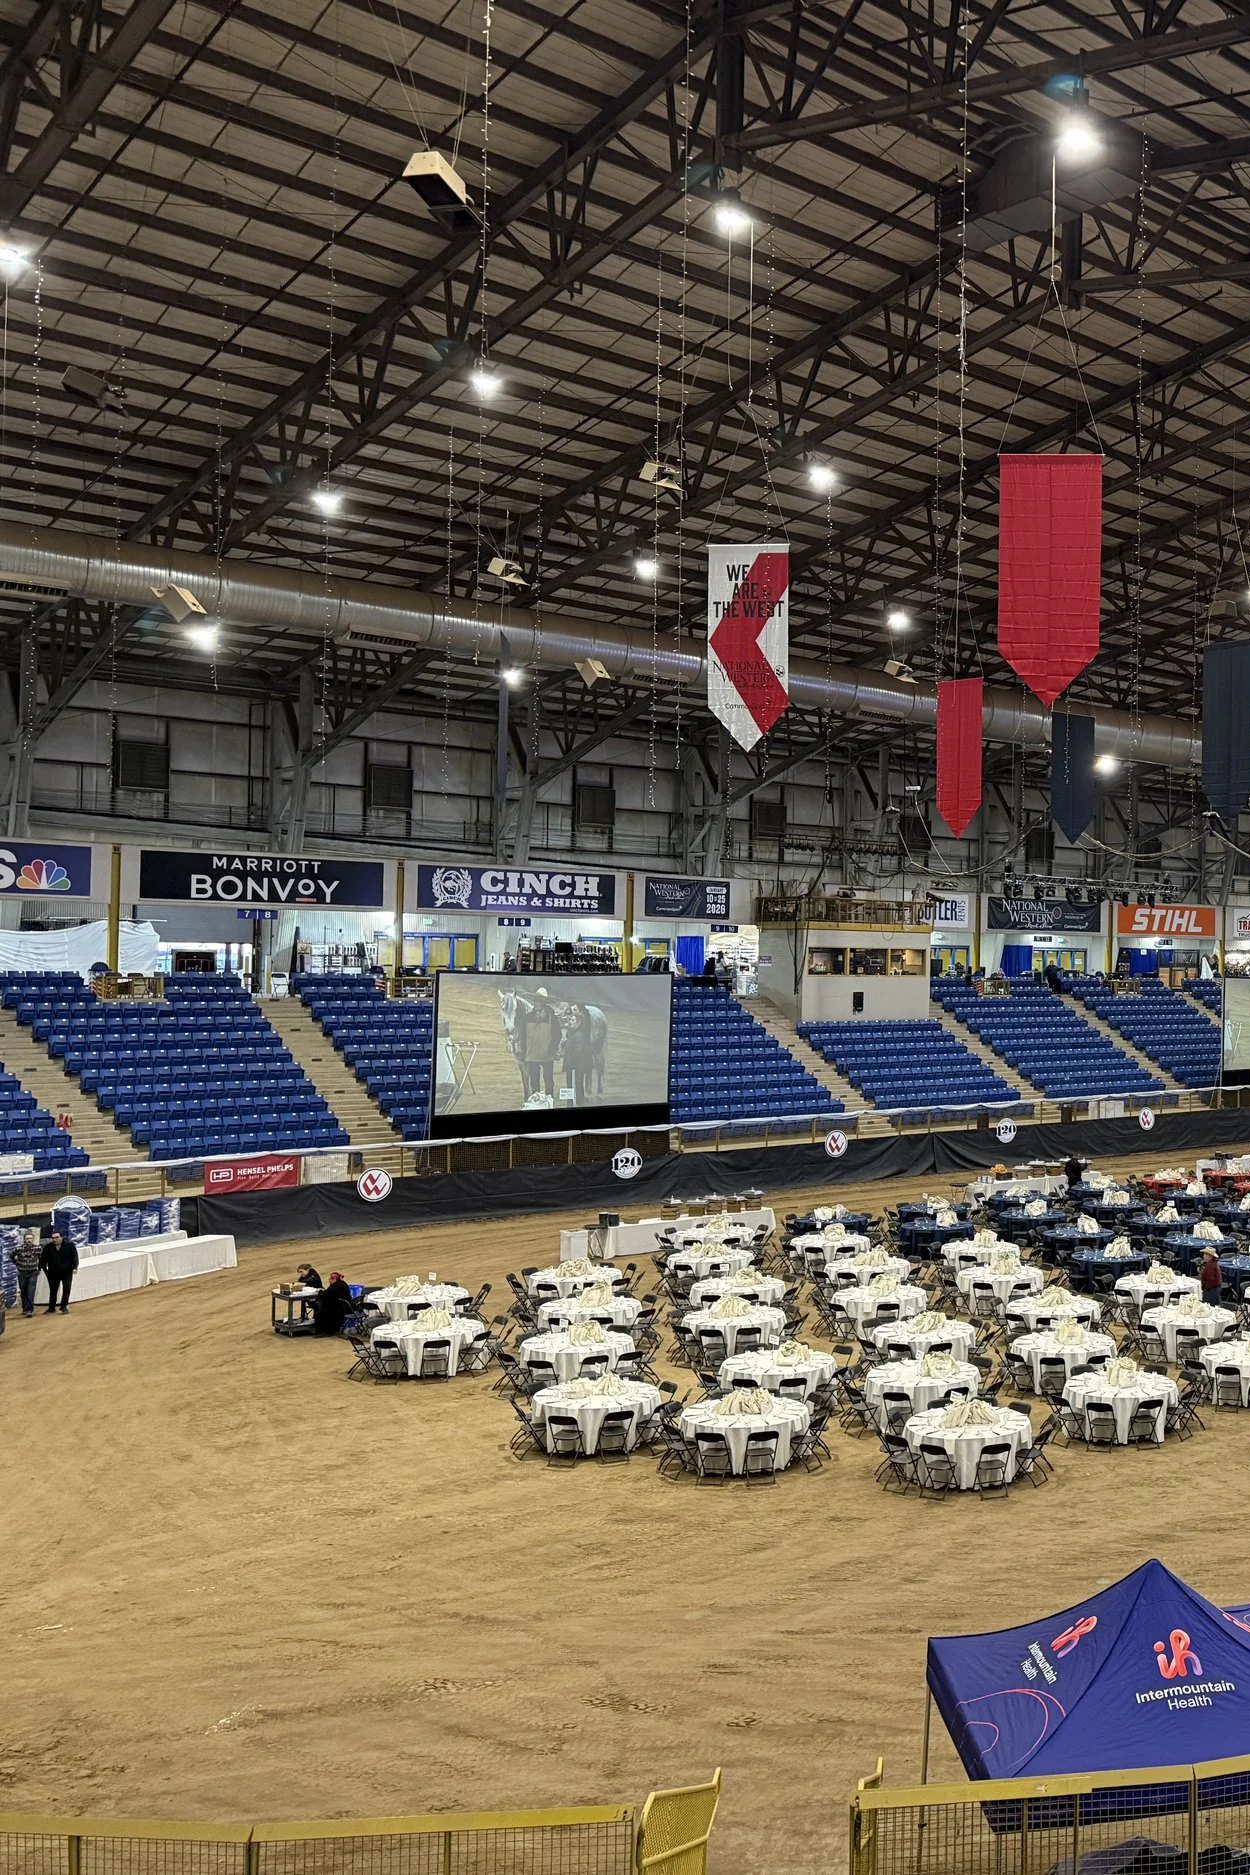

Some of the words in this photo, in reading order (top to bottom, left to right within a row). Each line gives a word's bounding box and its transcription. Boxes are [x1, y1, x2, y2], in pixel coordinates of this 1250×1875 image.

[726, 565, 749, 581] WE
[733, 583, 759, 599] ARE
[713, 601, 739, 618] THE
[743, 601, 784, 618] WEST
[212, 856, 322, 874] MARRIOTT
[190, 874, 340, 903] BONVOY
[480, 871, 600, 897] CINCH
[649, 882, 681, 891] NATIONAL
[655, 889, 685, 897] WESTERN
[706, 894, 713, 903] 10
[717, 895, 726, 903] 25
[480, 895, 528, 906] JEANS
[531, 897, 542, 906] &
[545, 897, 599, 909] SHIRTS
[706, 903, 726, 914] 2026
[1002, 899, 1049, 912] NATIONAL
[244, 910, 251, 918] 7
[958, 901, 966, 921] RENTS
[1009, 911, 1054, 923] WESTERN
[1132, 908, 1203, 932] STIHL
[237, 1166, 266, 1176] HENSEL
[266, 1163, 294, 1173] PHELPS
[612, 1155, 642, 1171] 120
[1020, 1657, 1039, 1681] Health
[1027, 1640, 1058, 1685] Intermountain
[1135, 1680, 1236, 1704] Intermountain
[1167, 1694, 1213, 1711] Health
